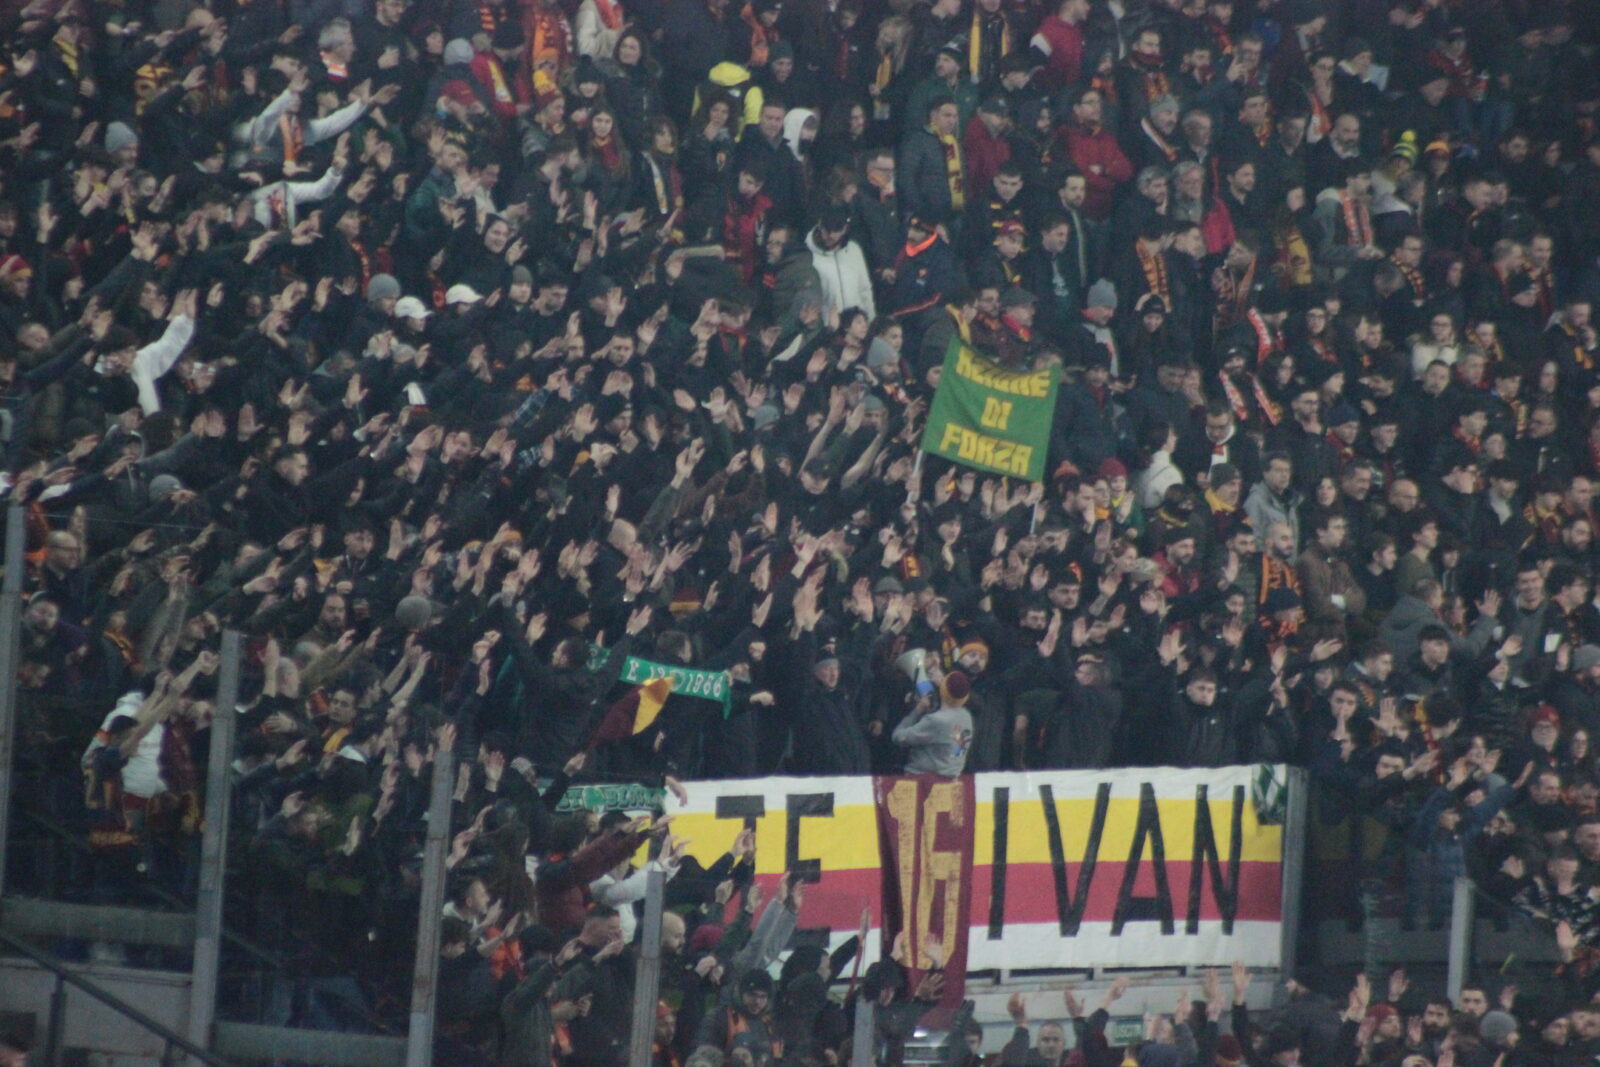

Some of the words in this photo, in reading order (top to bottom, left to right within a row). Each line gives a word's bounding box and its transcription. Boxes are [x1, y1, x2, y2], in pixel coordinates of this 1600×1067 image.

[939, 422, 1033, 476] FORZA
[981, 396, 1013, 430] DI
[887, 779, 964, 970] 16
[987, 782, 1245, 941] IVAN
